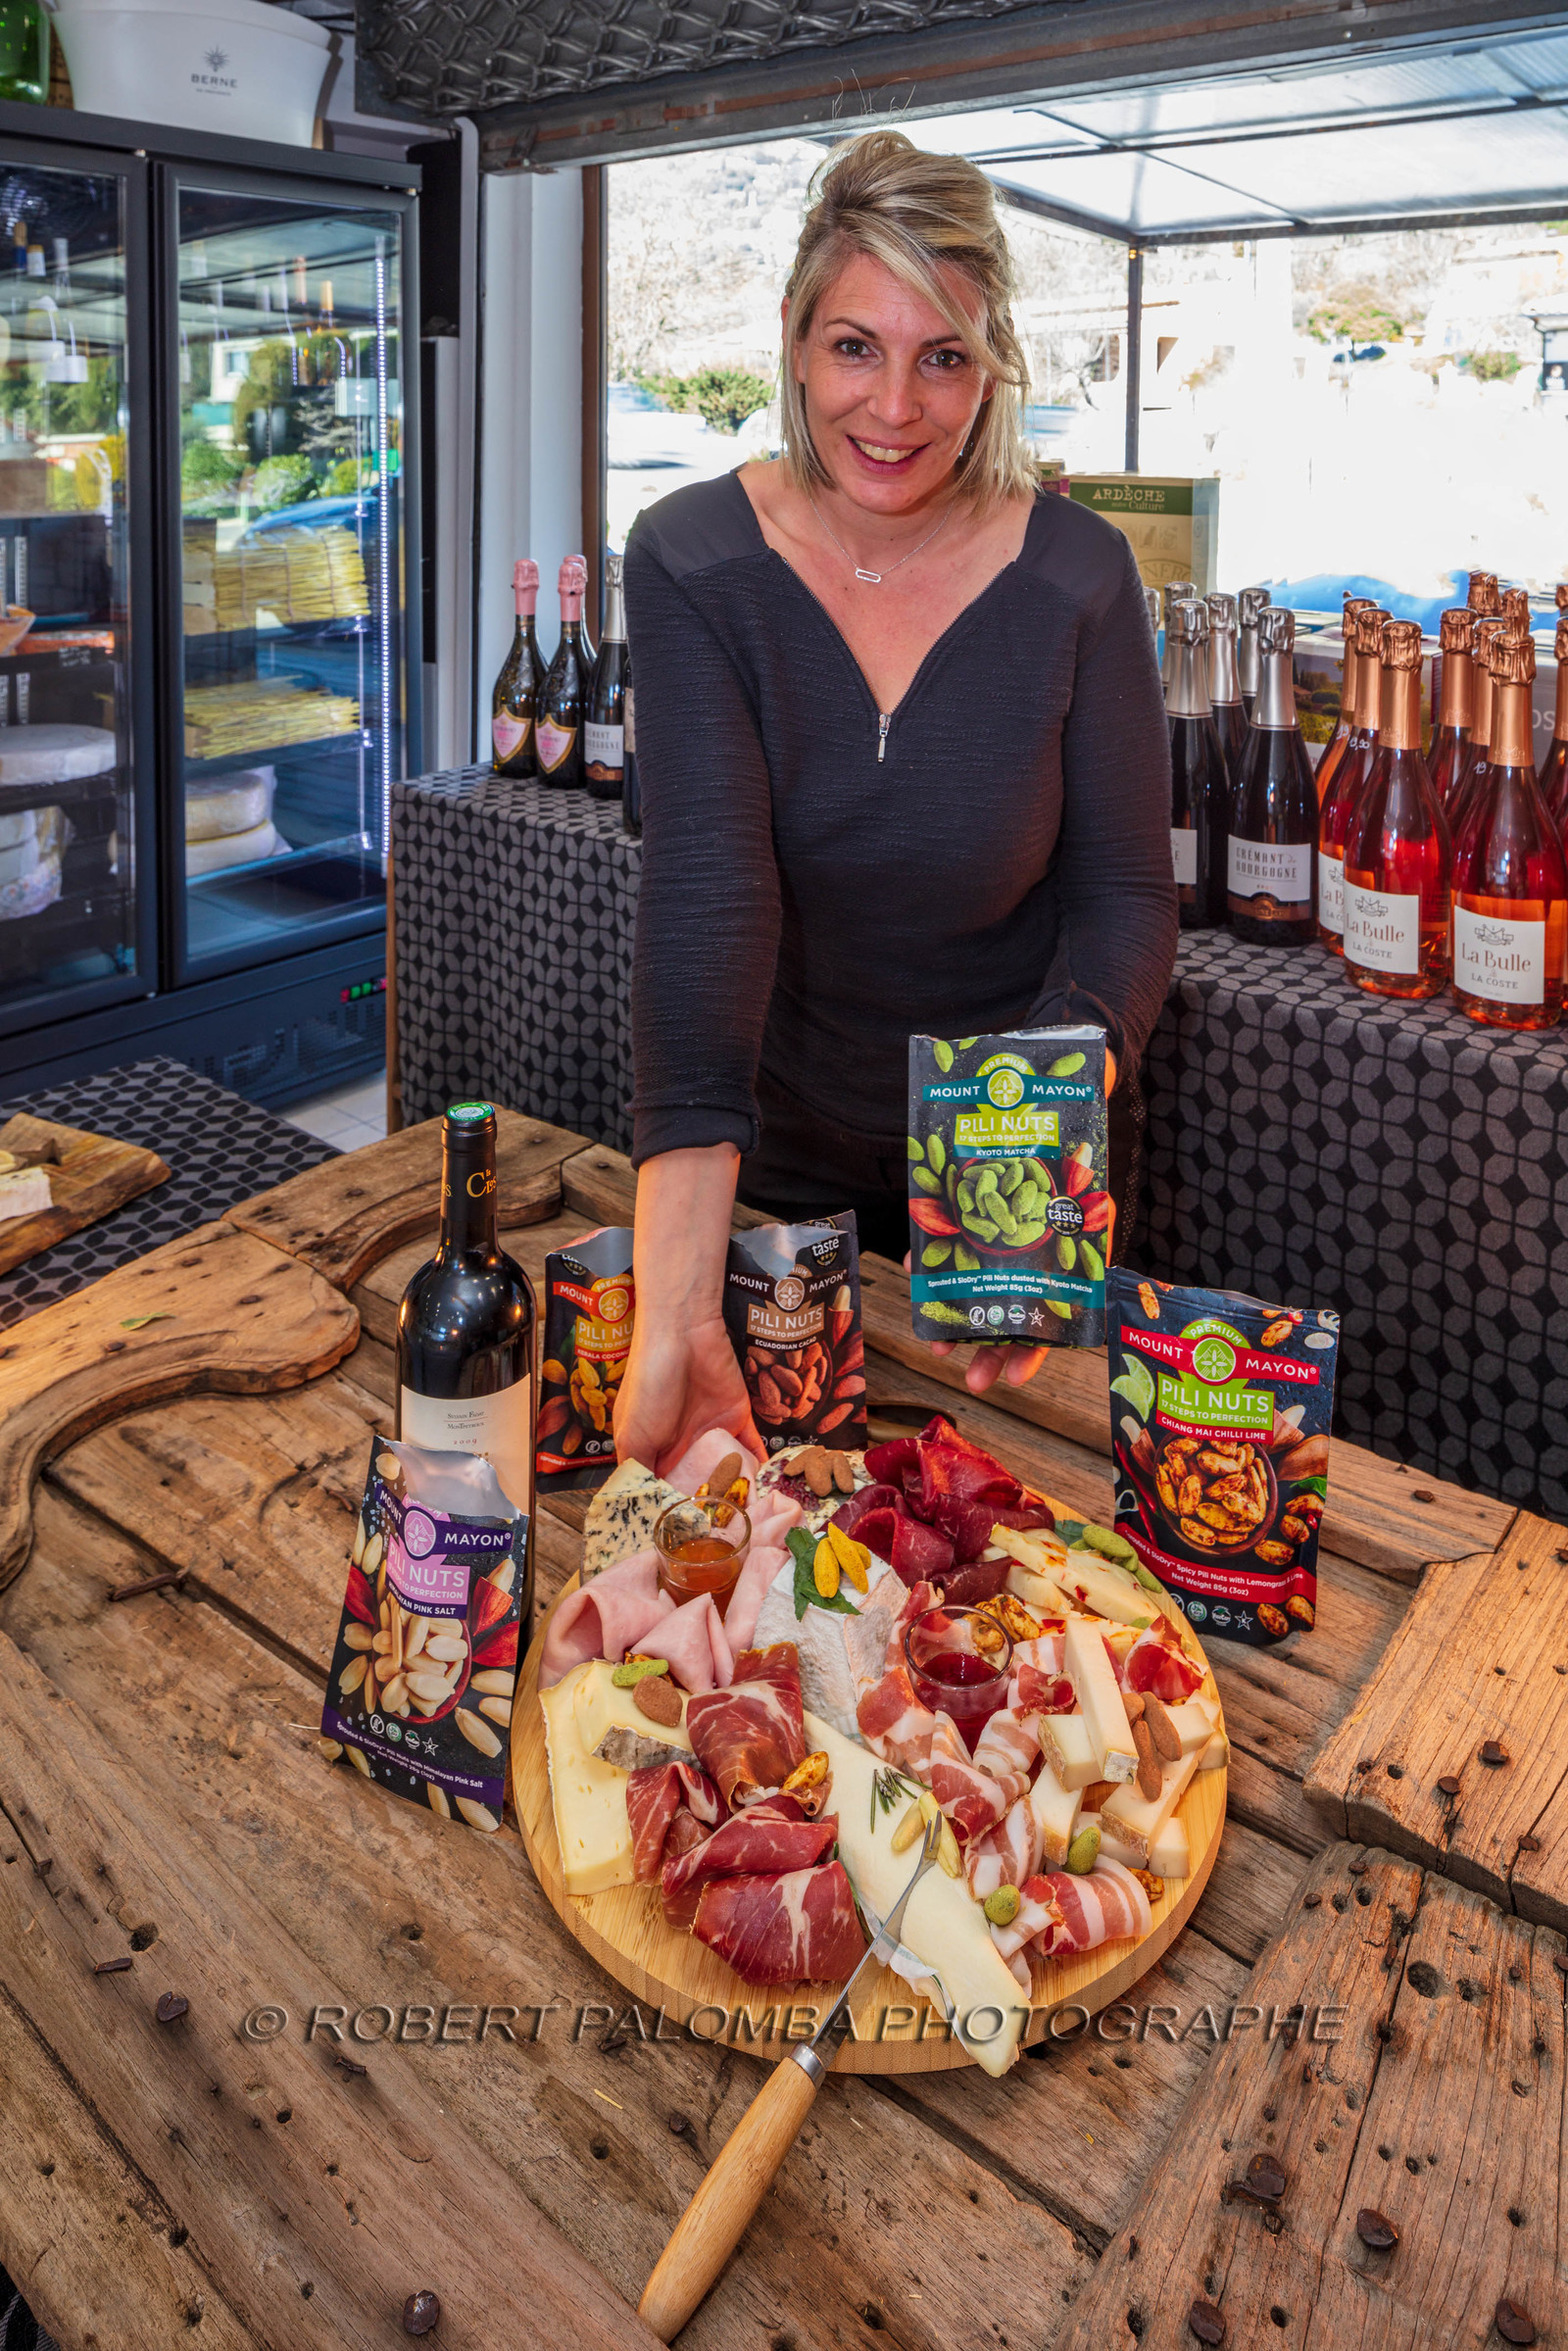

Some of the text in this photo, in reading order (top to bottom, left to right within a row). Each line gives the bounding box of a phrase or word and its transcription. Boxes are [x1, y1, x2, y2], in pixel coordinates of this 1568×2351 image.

[190, 73, 238, 88] BERNE
[1093, 485, 1165, 502] ARDÈCHE
[1128, 501, 1165, 511] Culture
[1236, 860, 1298, 879] BOURGOGNE
[1347, 912, 1359, 933] La
[1363, 920, 1404, 943] Bulle
[1352, 942, 1393, 958] LA COSTE
[1462, 942, 1531, 972] La Bulle
[1471, 972, 1483, 984] LA
[1486, 977, 1518, 989] COSTE
[984, 1056, 1028, 1073] PREMIUM
[930, 1086, 981, 1098] MOUNT
[959, 1116, 1055, 1133] PILI NUTS
[1004, 1148, 1036, 1156] MATCHA
[1054, 1202, 1074, 1211] great
[1048, 1208, 1083, 1224] taste
[811, 1237, 840, 1256] taste
[729, 1274, 769, 1293] MOUNT
[985, 1285, 1008, 1295] Weight
[1009, 1285, 1023, 1294] 85g
[1024, 1285, 1043, 1295] (3oz)
[1036, 1277, 1050, 1286] with
[1051, 1279, 1070, 1289] Kyoto
[1070, 1282, 1093, 1294] Matcha
[560, 1285, 594, 1306] MOUNT
[751, 1307, 822, 1329] PILI NUTS
[579, 1321, 633, 1341] PILI NU
[757, 1328, 776, 1337] STEPS
[787, 1322, 822, 1338] PERFECTION
[1191, 1323, 1243, 1345] PREMIUM
[584, 1339, 603, 1348] STEPS
[755, 1337, 817, 1349] ECUADORIAN CACAO
[1129, 1332, 1184, 1359] MOUNT
[1162, 1379, 1269, 1413] PILI NUTS
[1169, 1404, 1196, 1419] STEPS
[1197, 1411, 1209, 1420] TO
[1211, 1413, 1268, 1424] PERFECTION
[1161, 1416, 1193, 1435] CHIANG
[1196, 1427, 1212, 1437] MAI
[1214, 1430, 1244, 1439] CHILLI
[379, 1490, 403, 1525] MOUNT
[389, 1543, 465, 1588] PILI NUTS
[1177, 1564, 1196, 1577] Spicy
[1210, 1573, 1228, 1582] Nuts
[1229, 1575, 1245, 1585] with
[402, 1581, 410, 1591] TO
[410, 1586, 463, 1599] PERFECTION
[1171, 1572, 1249, 1596] Net Weight 85g (3oz)
[414, 1603, 432, 1614] PINK
[337, 1721, 359, 1739] Sprouted
[396, 1753, 410, 1762] Nuts
[411, 1758, 422, 1768] with
[423, 1762, 454, 1782] Himalayan
[455, 1775, 468, 1785] Pink
[469, 1779, 483, 1788] Salt
